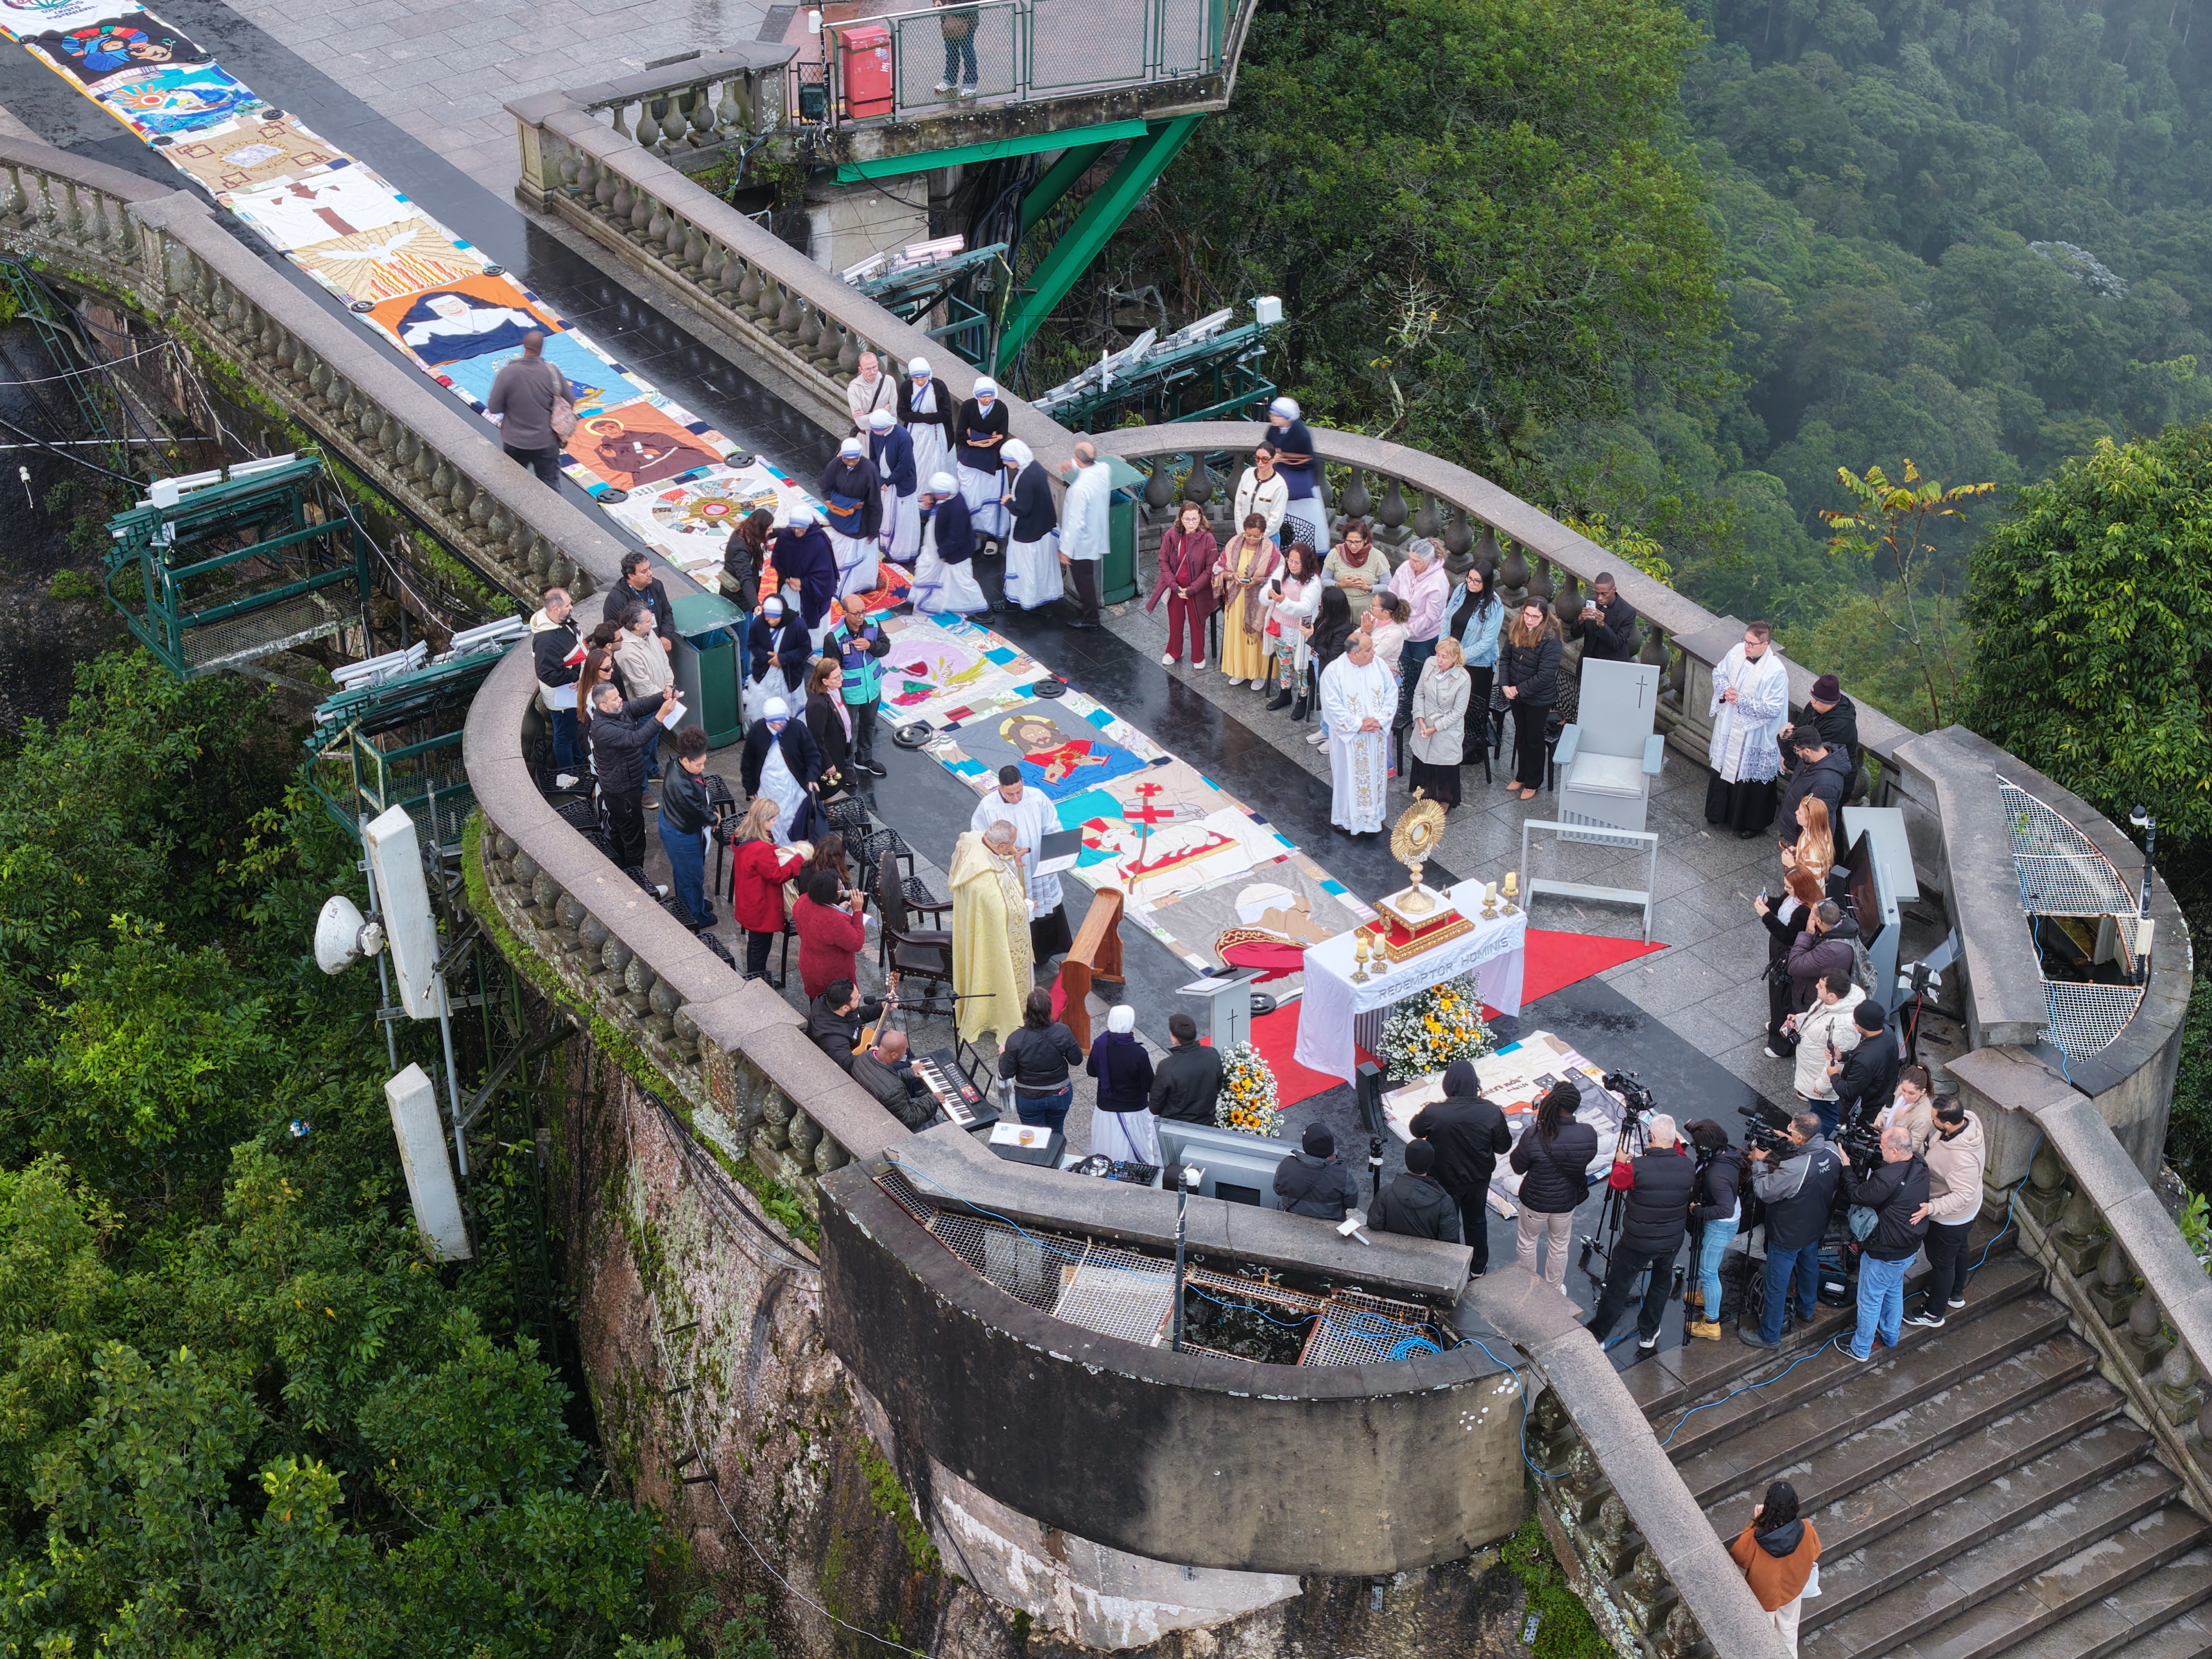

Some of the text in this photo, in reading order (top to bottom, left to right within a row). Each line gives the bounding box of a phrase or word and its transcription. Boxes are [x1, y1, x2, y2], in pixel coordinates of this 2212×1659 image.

[54, 5, 81, 15] CRISTO
[1379, 937, 1509, 1000] REDEMPTOR HOMINIS
